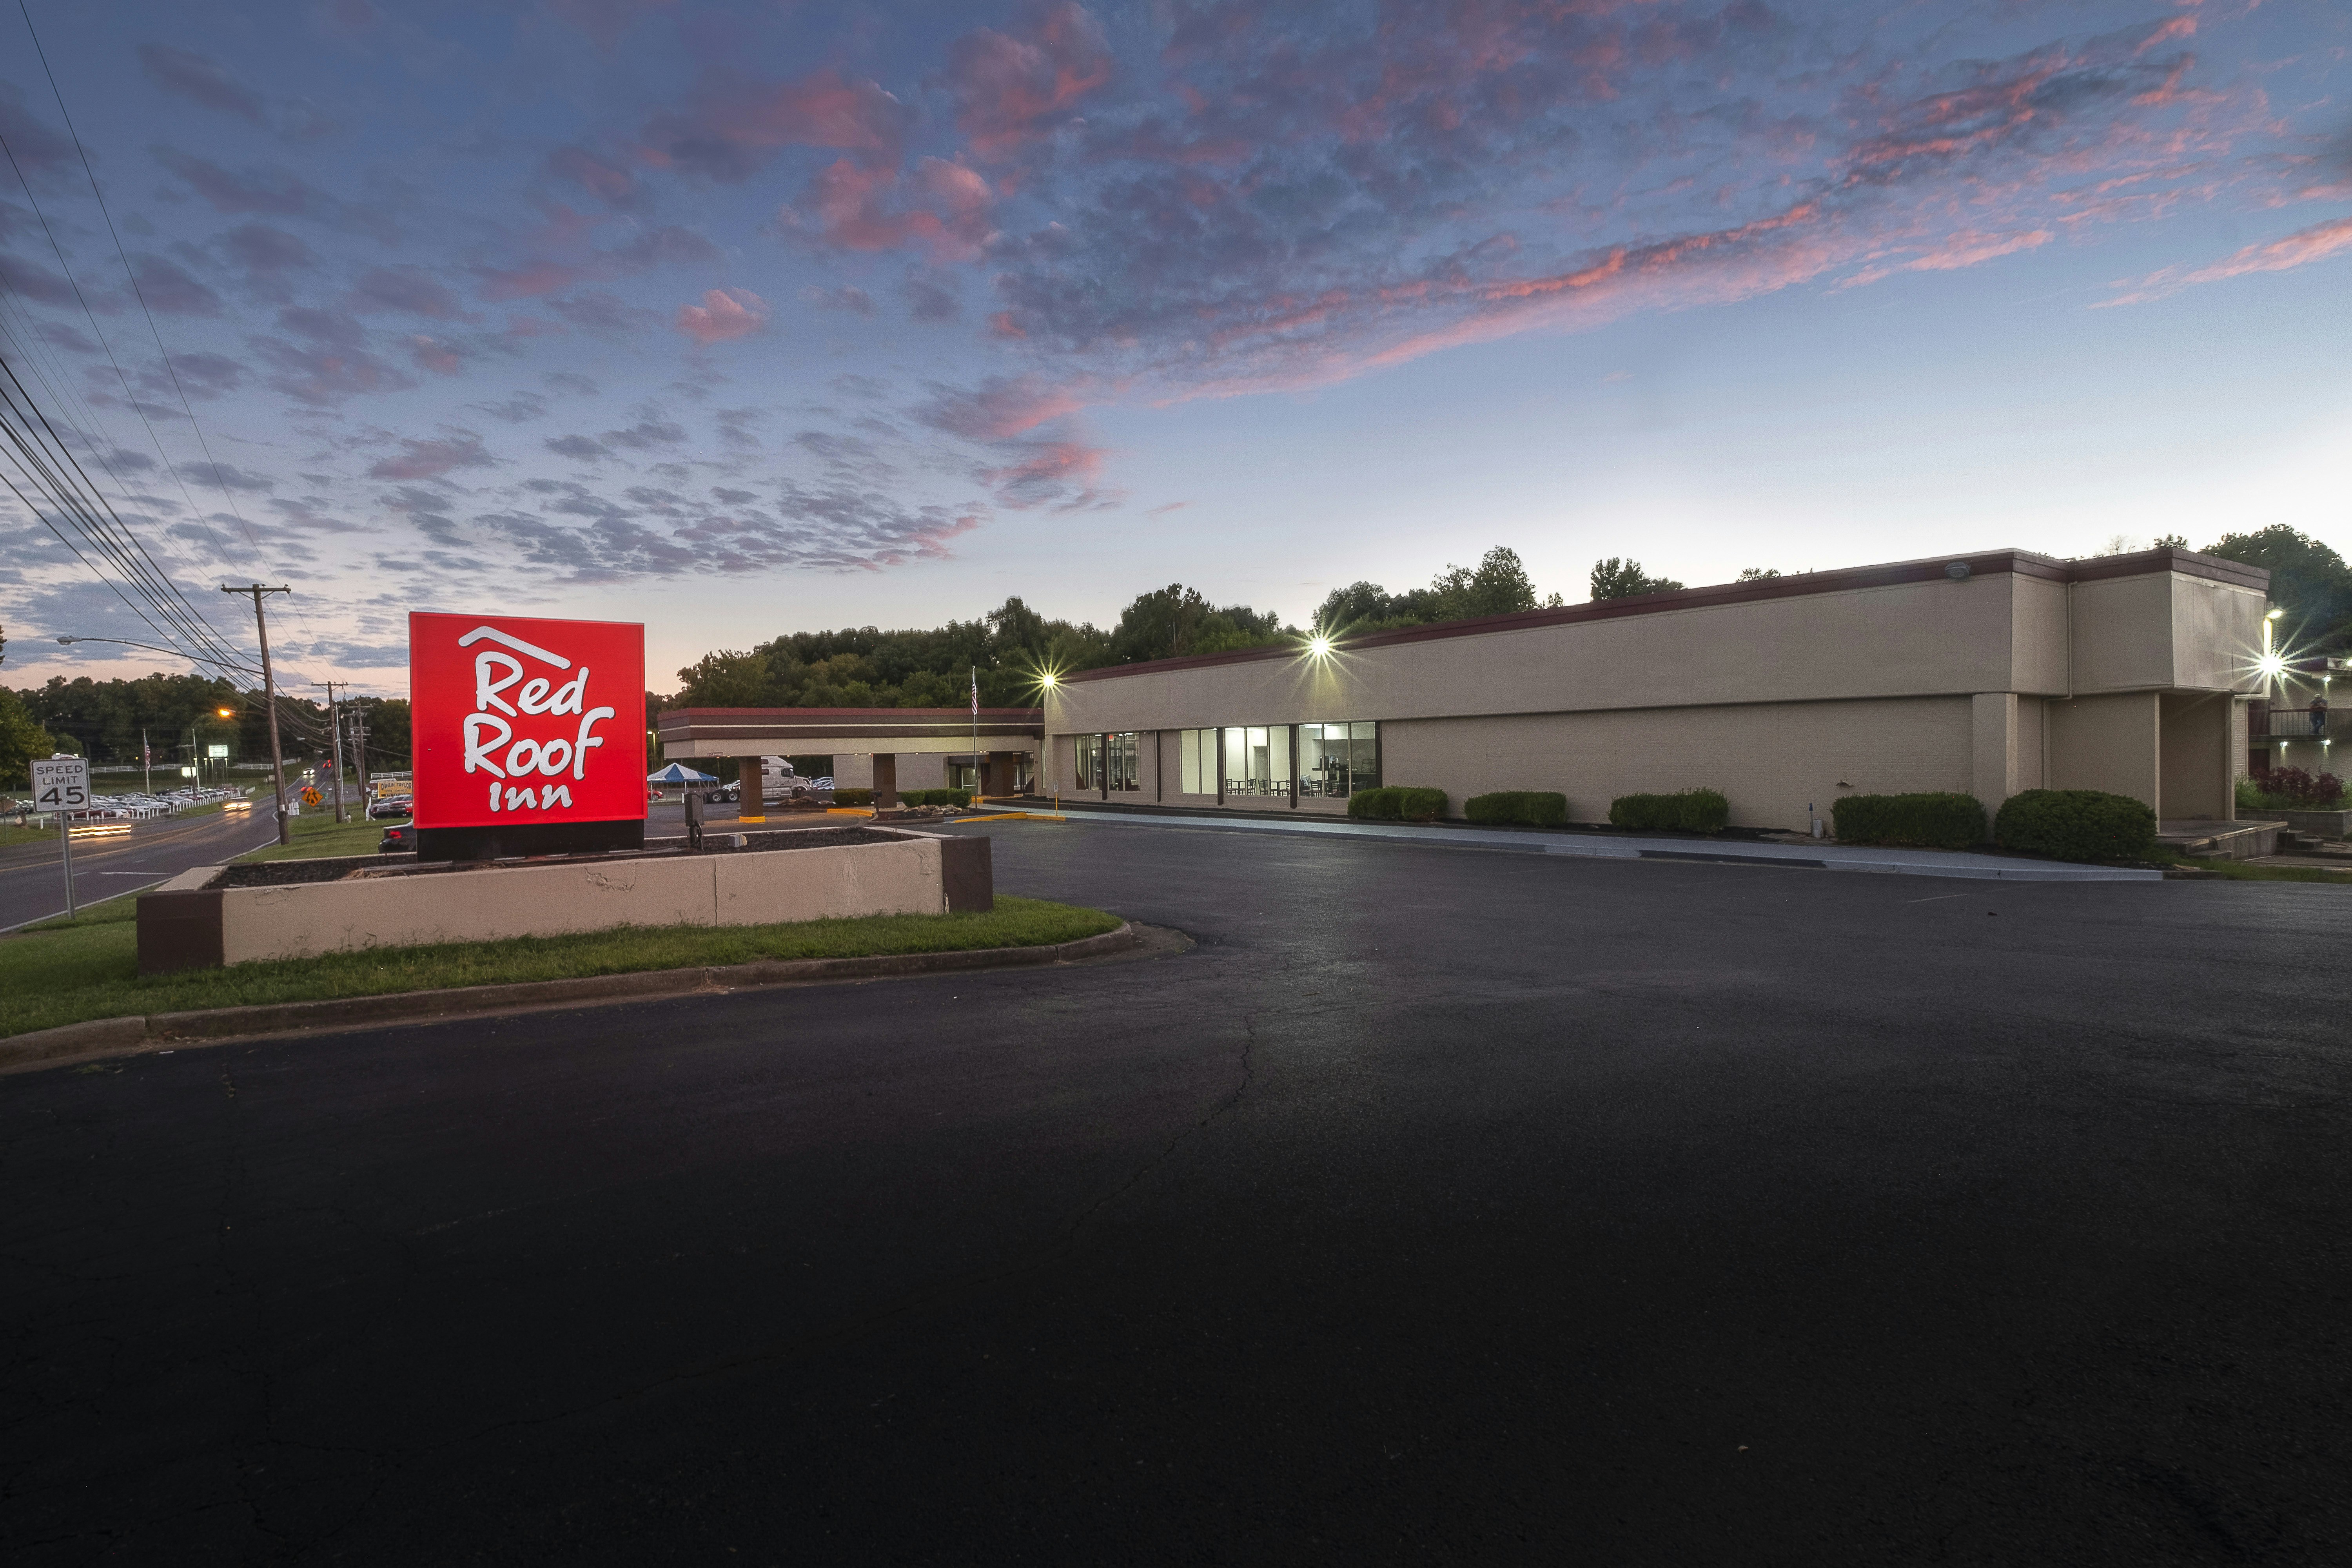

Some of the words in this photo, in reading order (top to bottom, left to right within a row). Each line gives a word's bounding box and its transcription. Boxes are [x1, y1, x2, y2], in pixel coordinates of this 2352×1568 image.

[475, 651, 590, 717] Red
[463, 706, 615, 780] Roof
[36, 765, 83, 775] SPEED
[43, 776, 78, 785] LIMIT
[40, 786, 85, 805] 45
